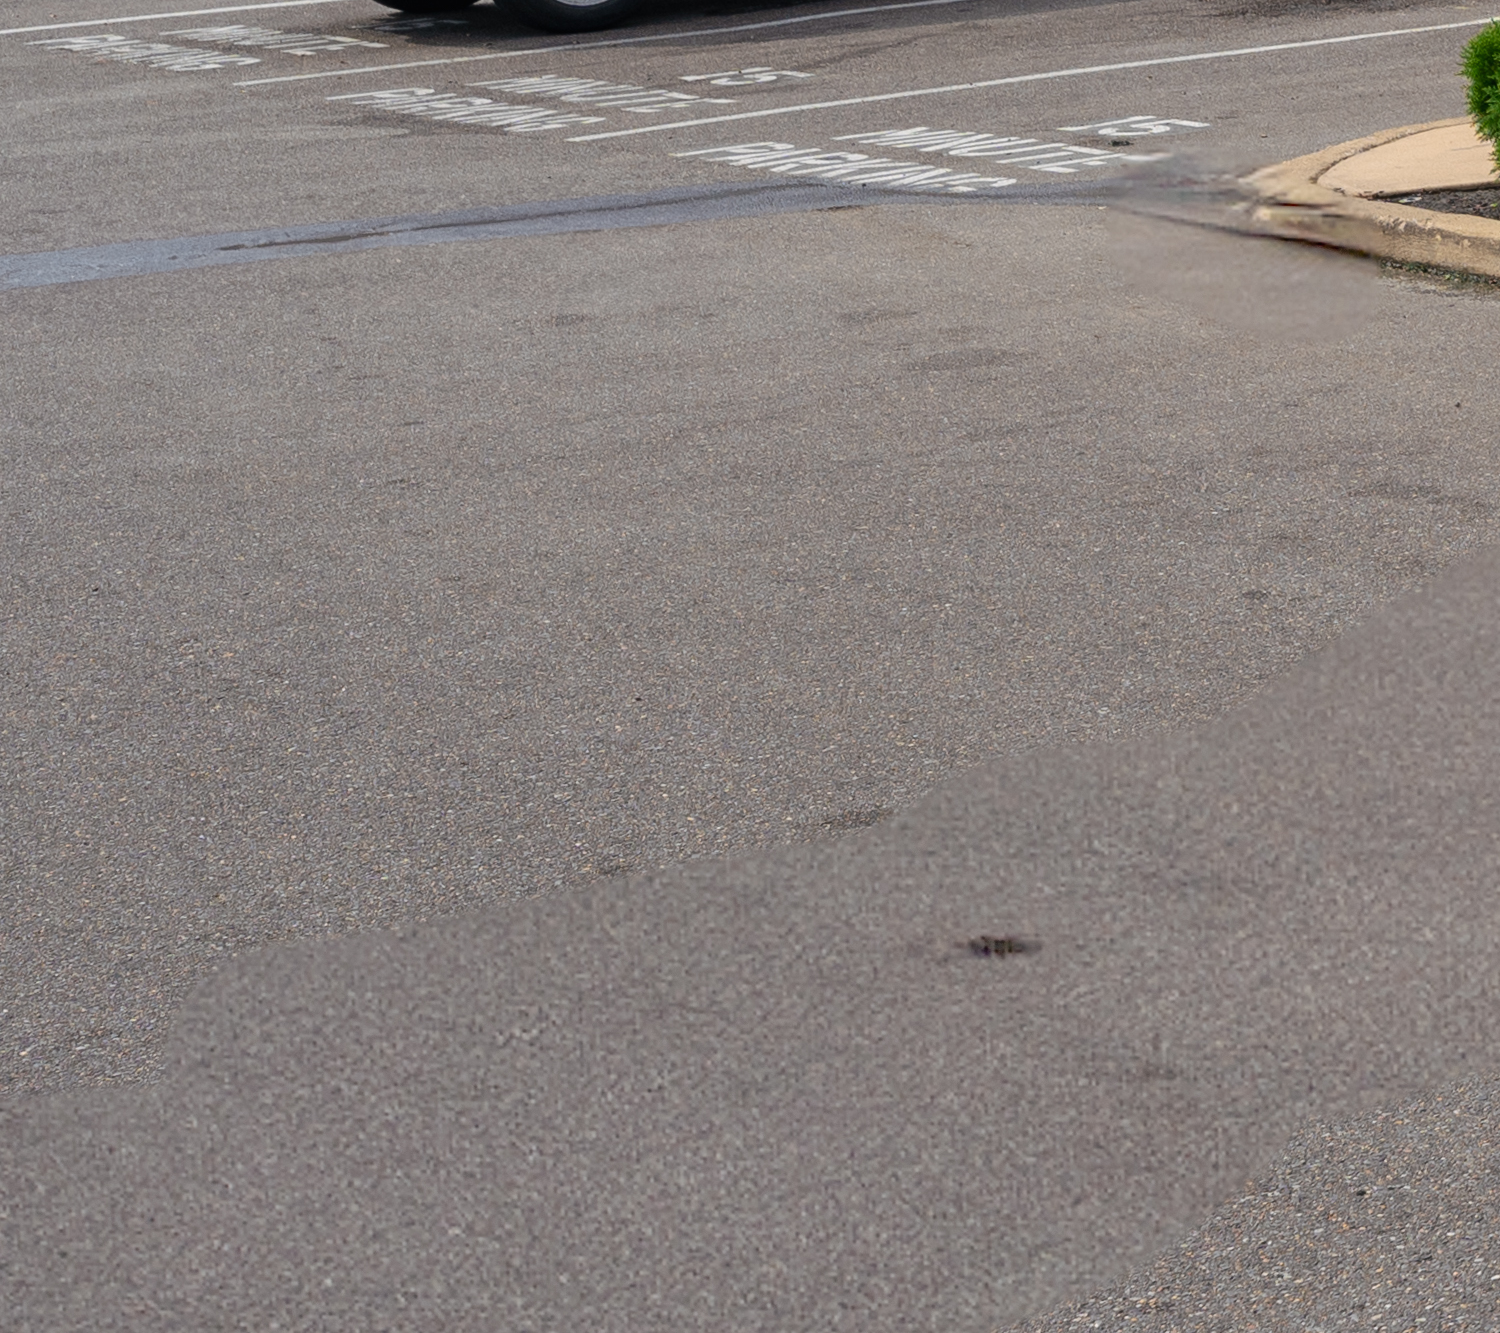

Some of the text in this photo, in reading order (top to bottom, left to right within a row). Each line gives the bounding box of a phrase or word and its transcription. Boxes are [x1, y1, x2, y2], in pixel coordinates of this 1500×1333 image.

[465, 74, 740, 114] MINUTE
[679, 66, 816, 86] 15
[325, 87, 608, 132] PARKING
[1057, 115, 1212, 136] 15
[669, 141, 1018, 193] PARKING
